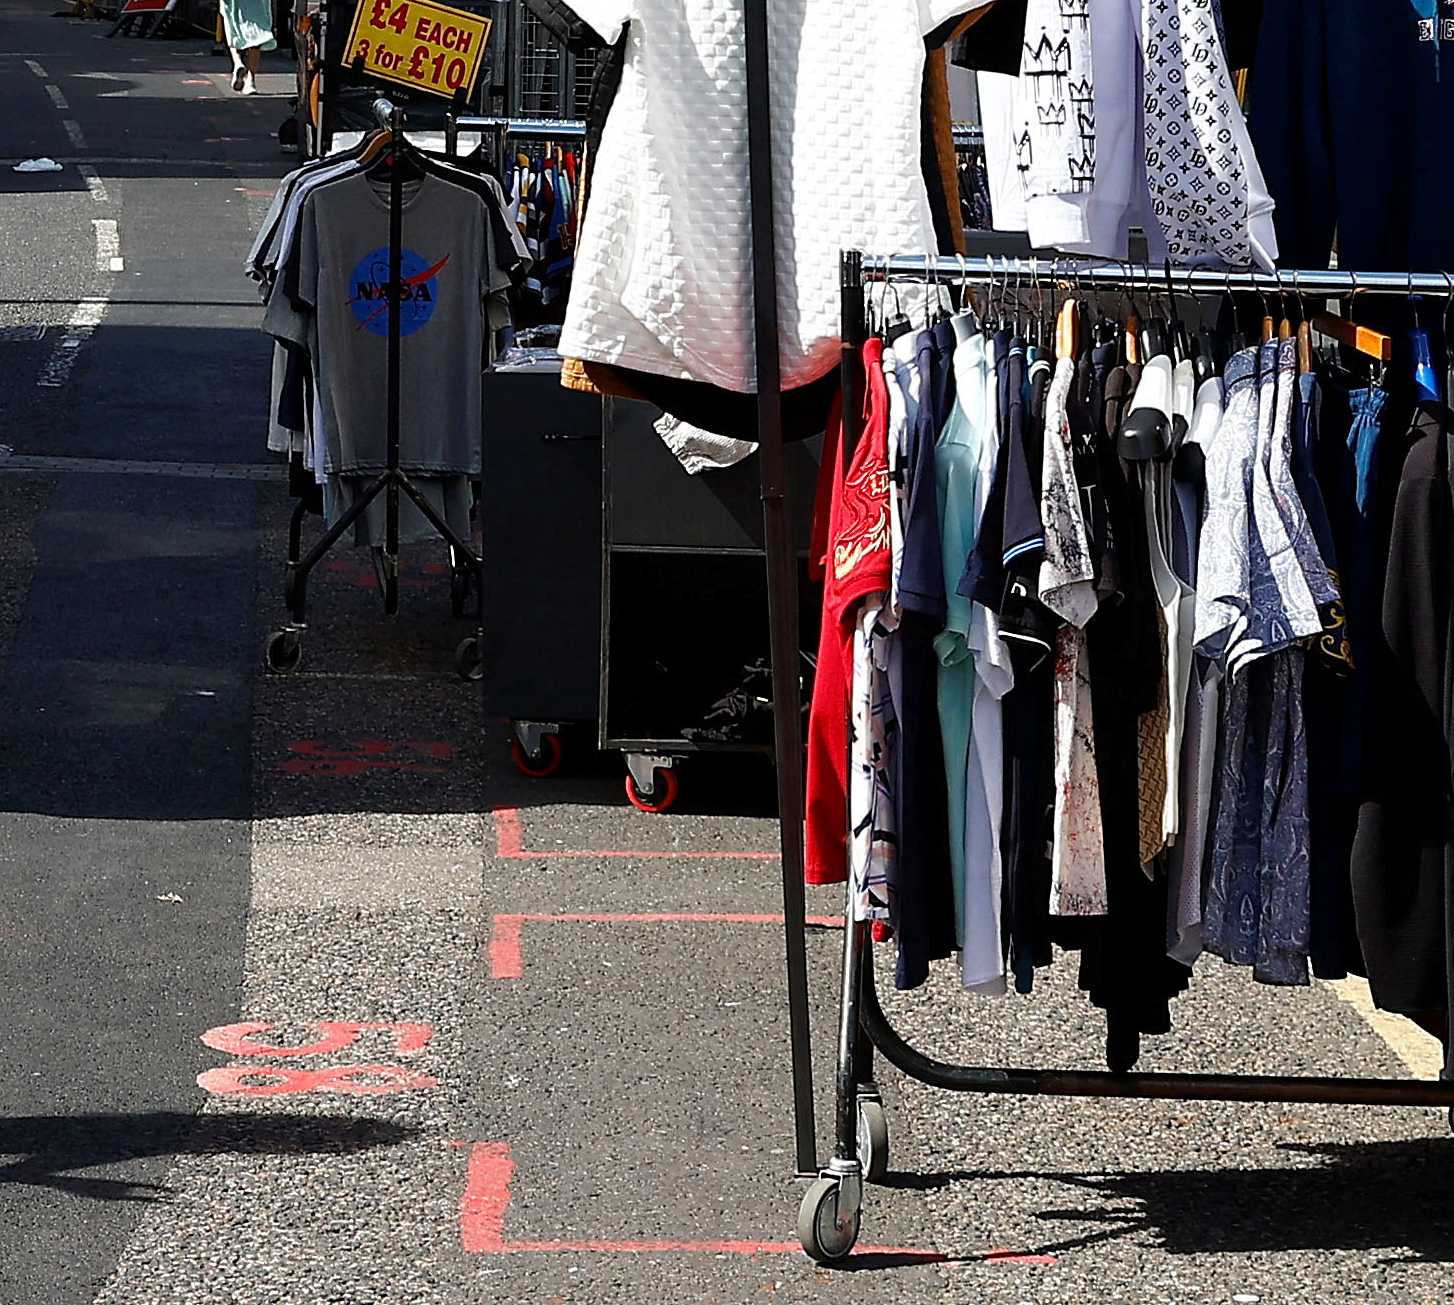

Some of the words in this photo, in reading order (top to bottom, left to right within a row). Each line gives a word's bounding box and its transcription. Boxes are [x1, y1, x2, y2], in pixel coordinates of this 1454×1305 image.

[414, 17, 474, 54] EACH
[355, 39, 370, 60] 3
[374, 44, 404, 71] for
[407, 45, 466, 90] £10
